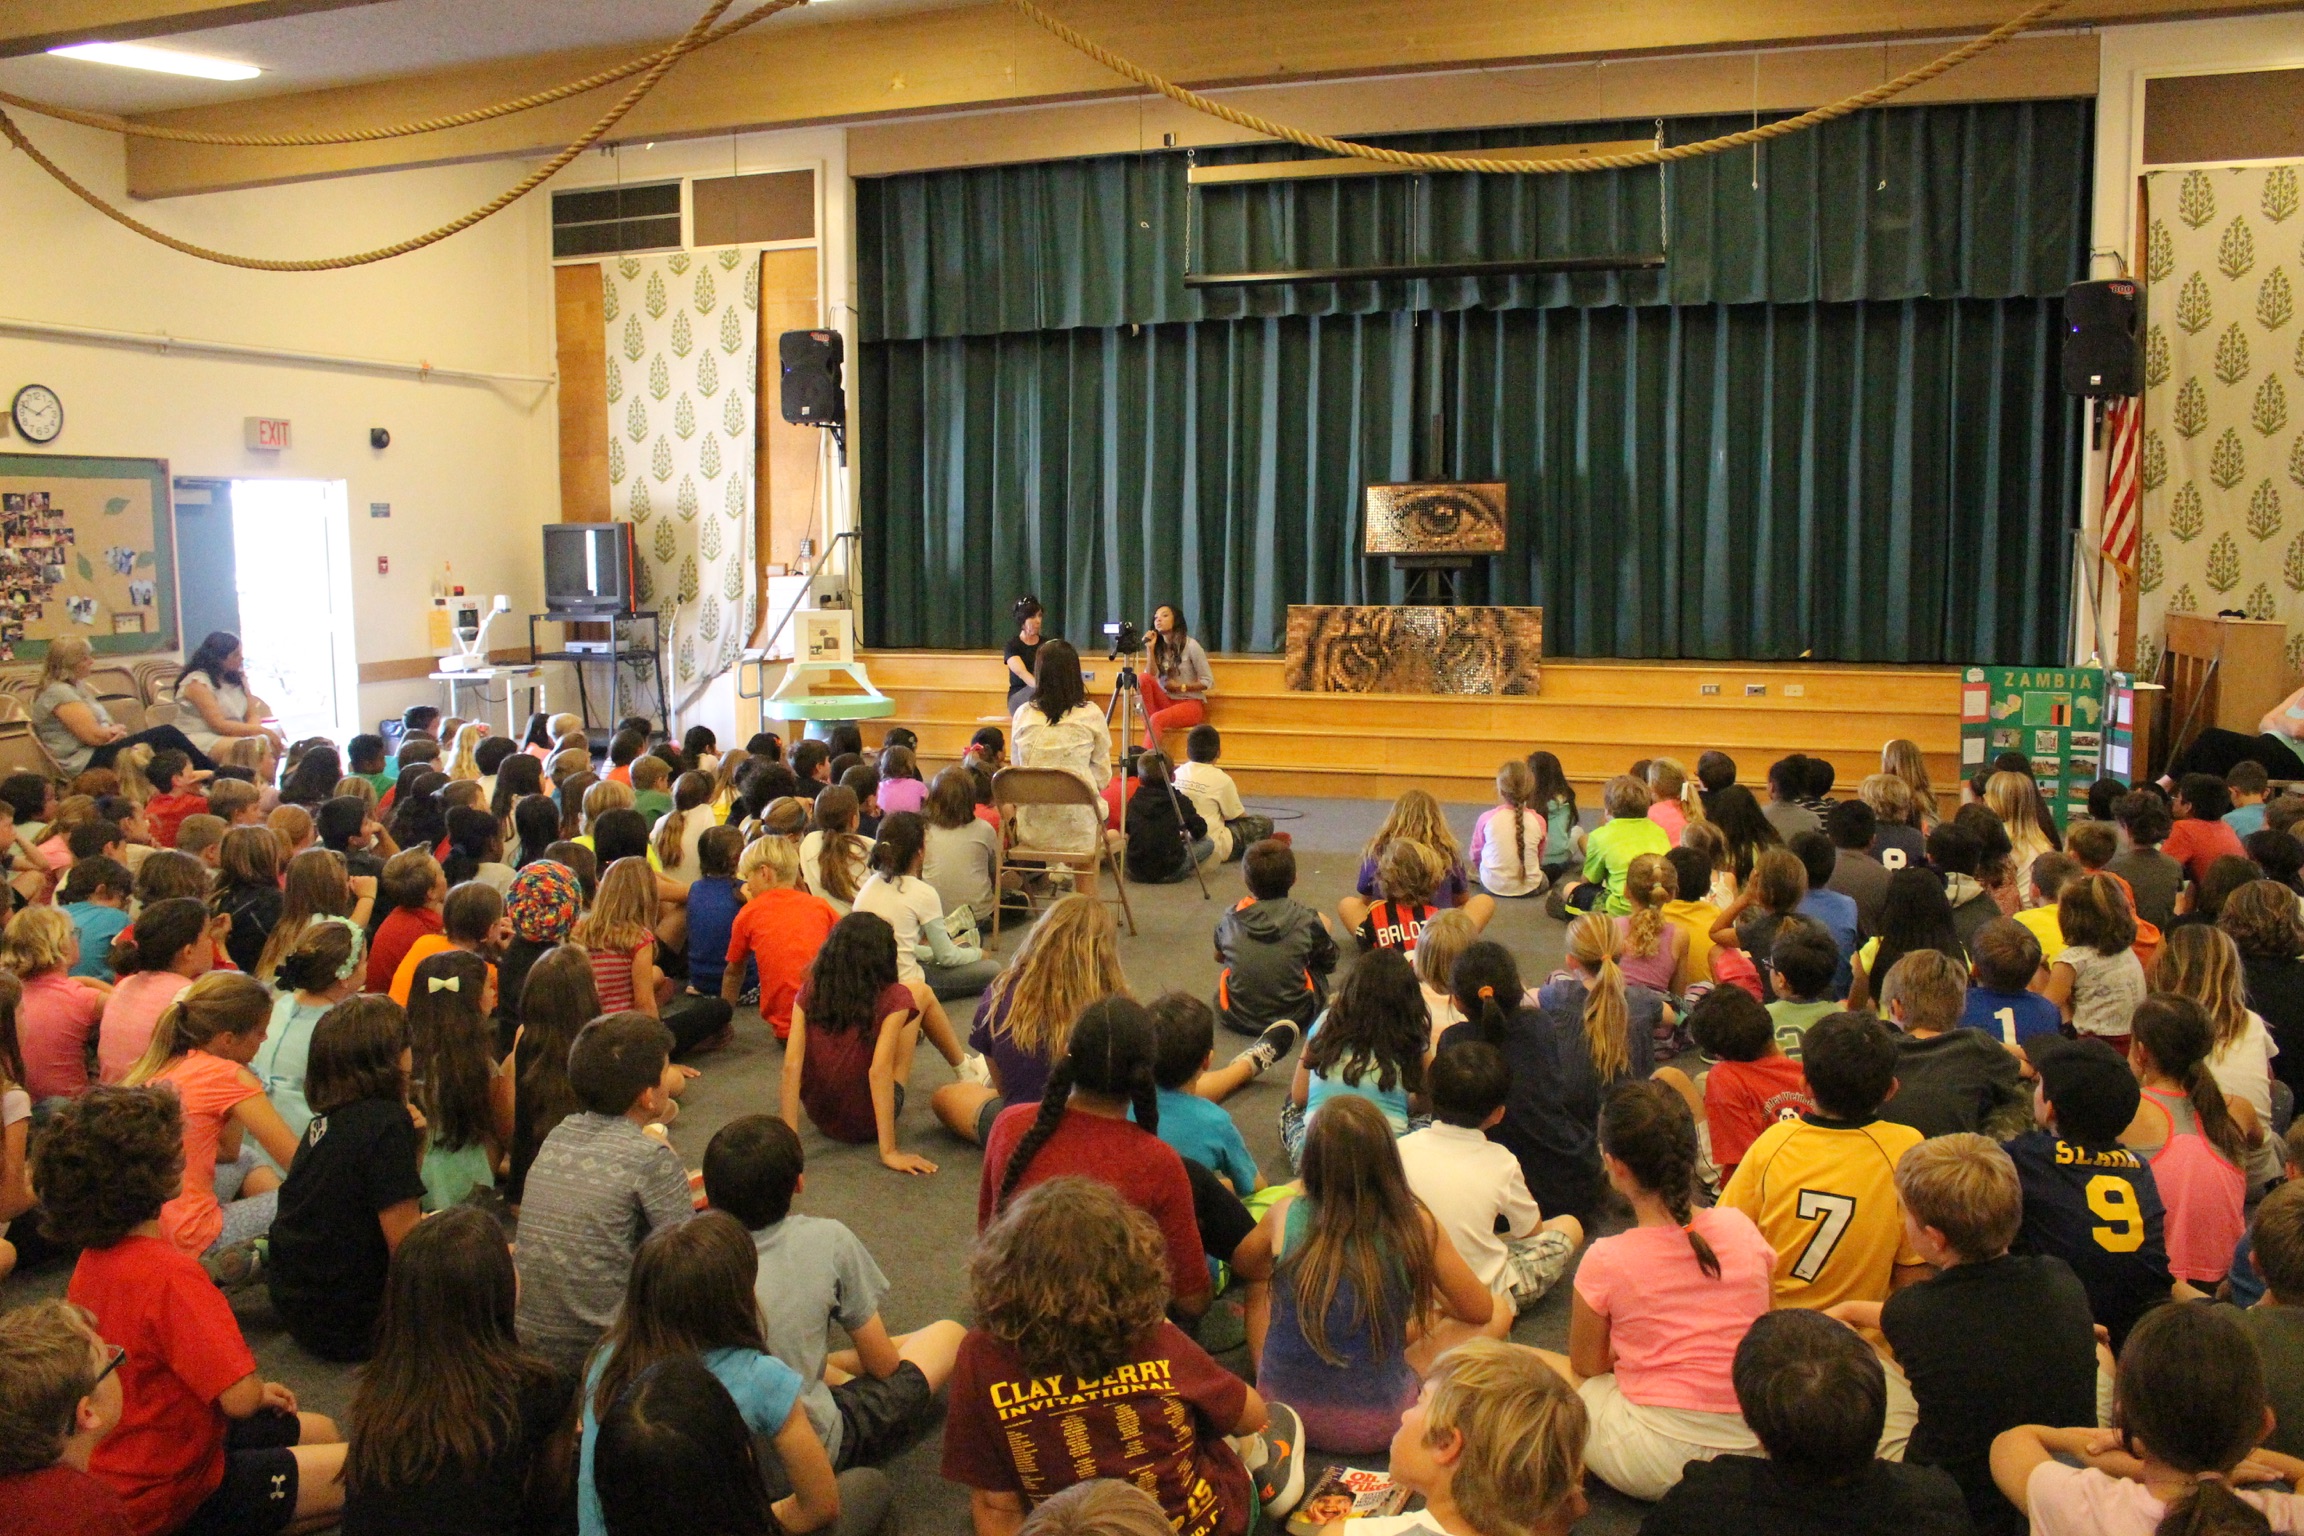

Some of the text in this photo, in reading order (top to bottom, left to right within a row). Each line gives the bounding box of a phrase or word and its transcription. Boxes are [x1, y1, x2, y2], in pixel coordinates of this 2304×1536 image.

[260, 420, 289, 446] EXIT
[2004, 671, 2092, 689] ZAMBIA
[1377, 920, 1428, 947] BALO
[2085, 1174, 2145, 1253] 9
[1790, 1188, 1857, 1285] 7
[989, 1374, 1063, 1410] CLAY
[997, 1380, 1176, 1421] INVITATIONAL
